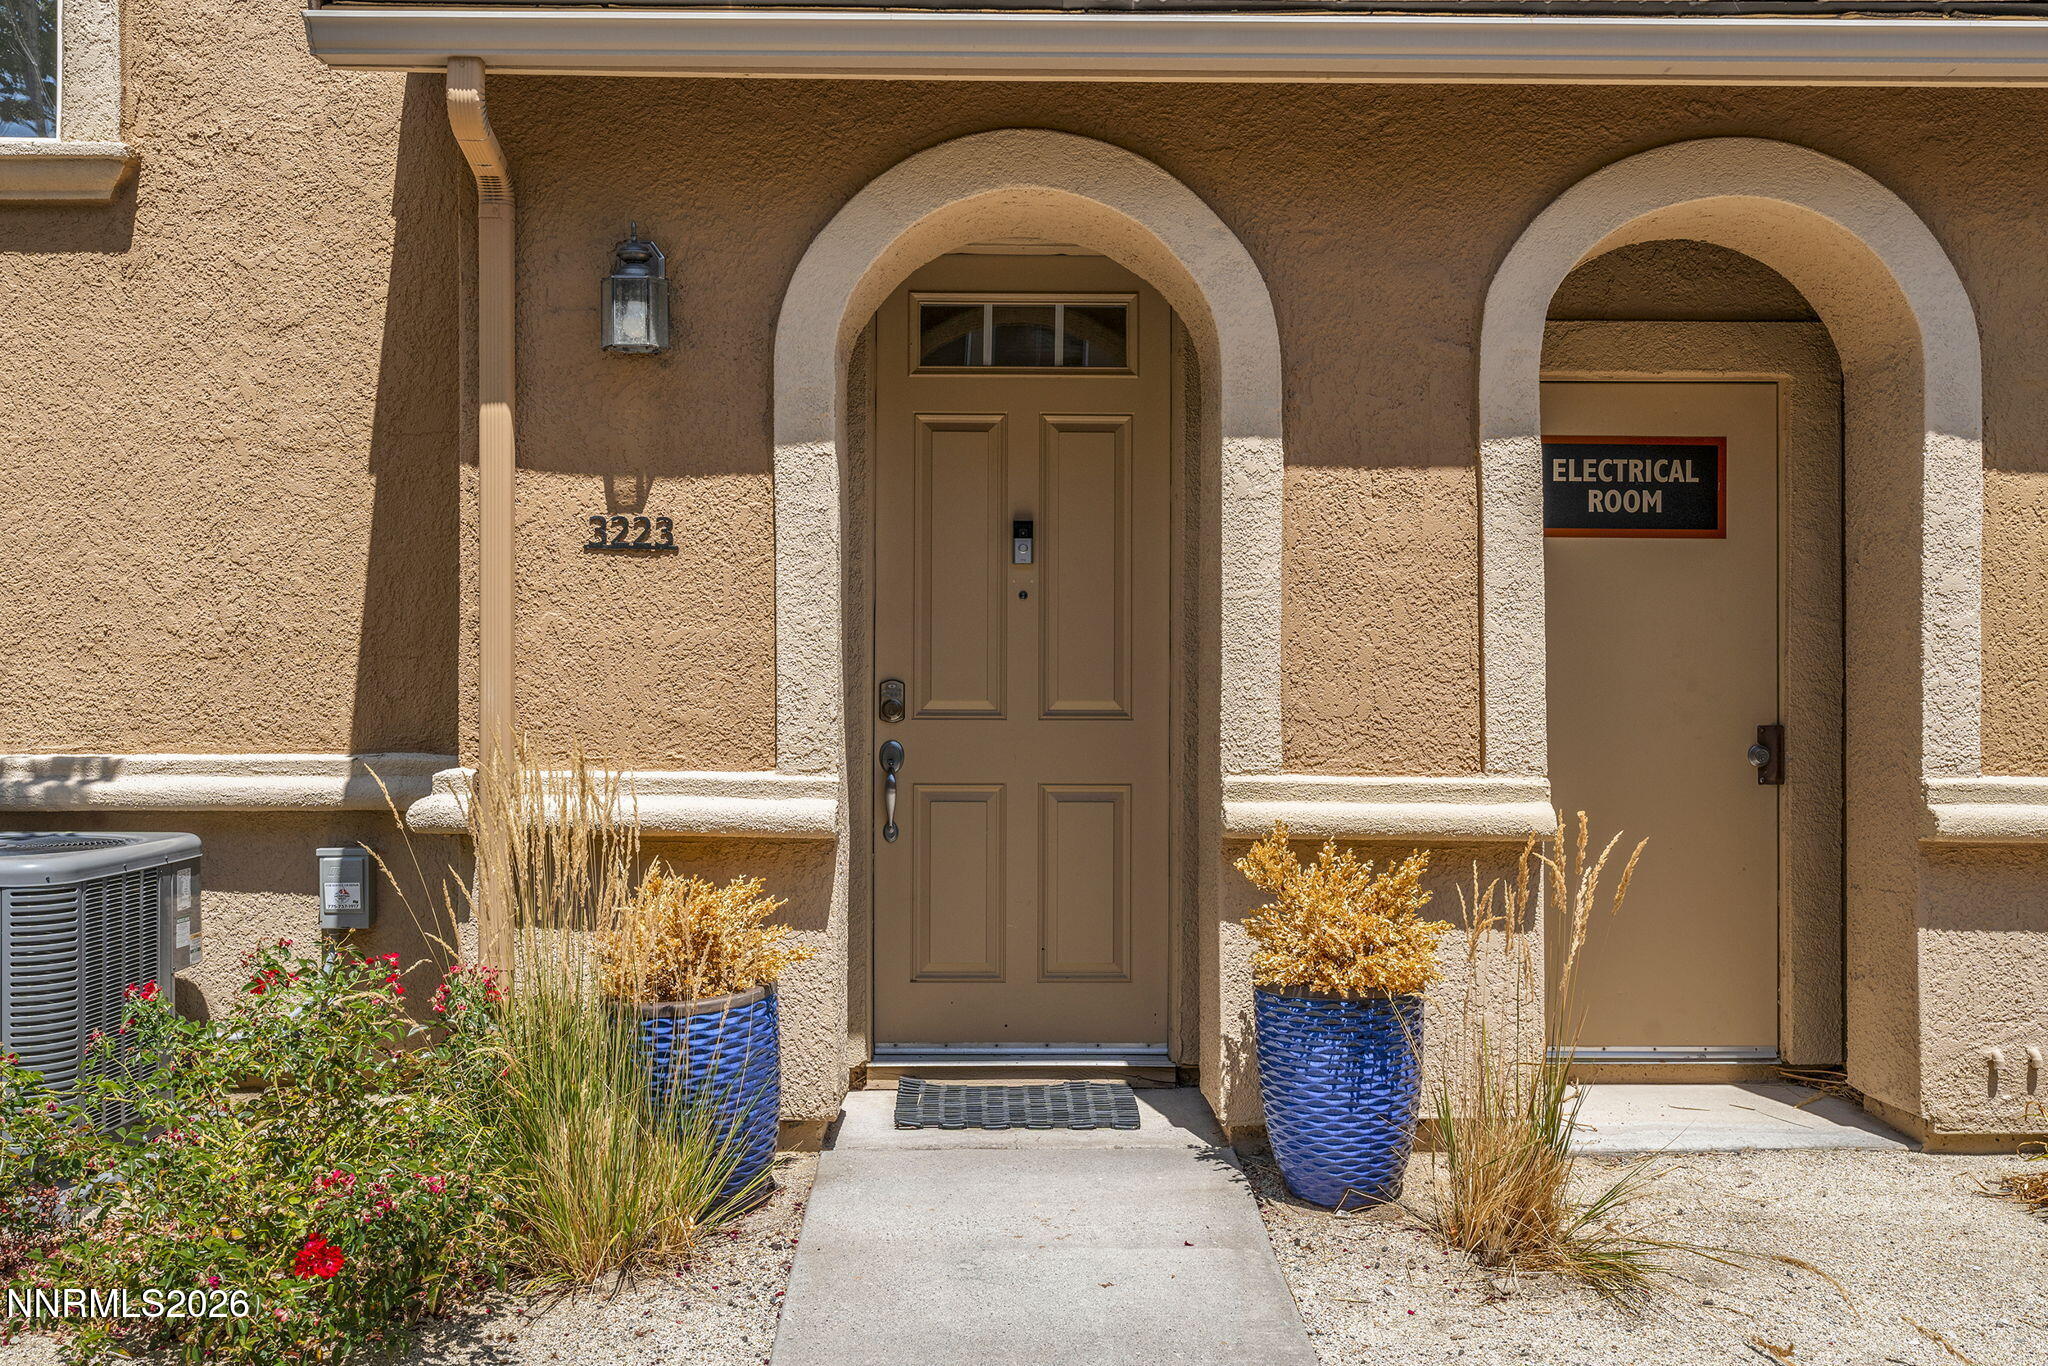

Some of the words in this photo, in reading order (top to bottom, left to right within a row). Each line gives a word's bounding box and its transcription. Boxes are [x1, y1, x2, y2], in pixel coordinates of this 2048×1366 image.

[1552, 458, 1699, 483] ELECTRICAL
[1588, 489, 1662, 513] ROOM
[588, 515, 674, 546] 3223
